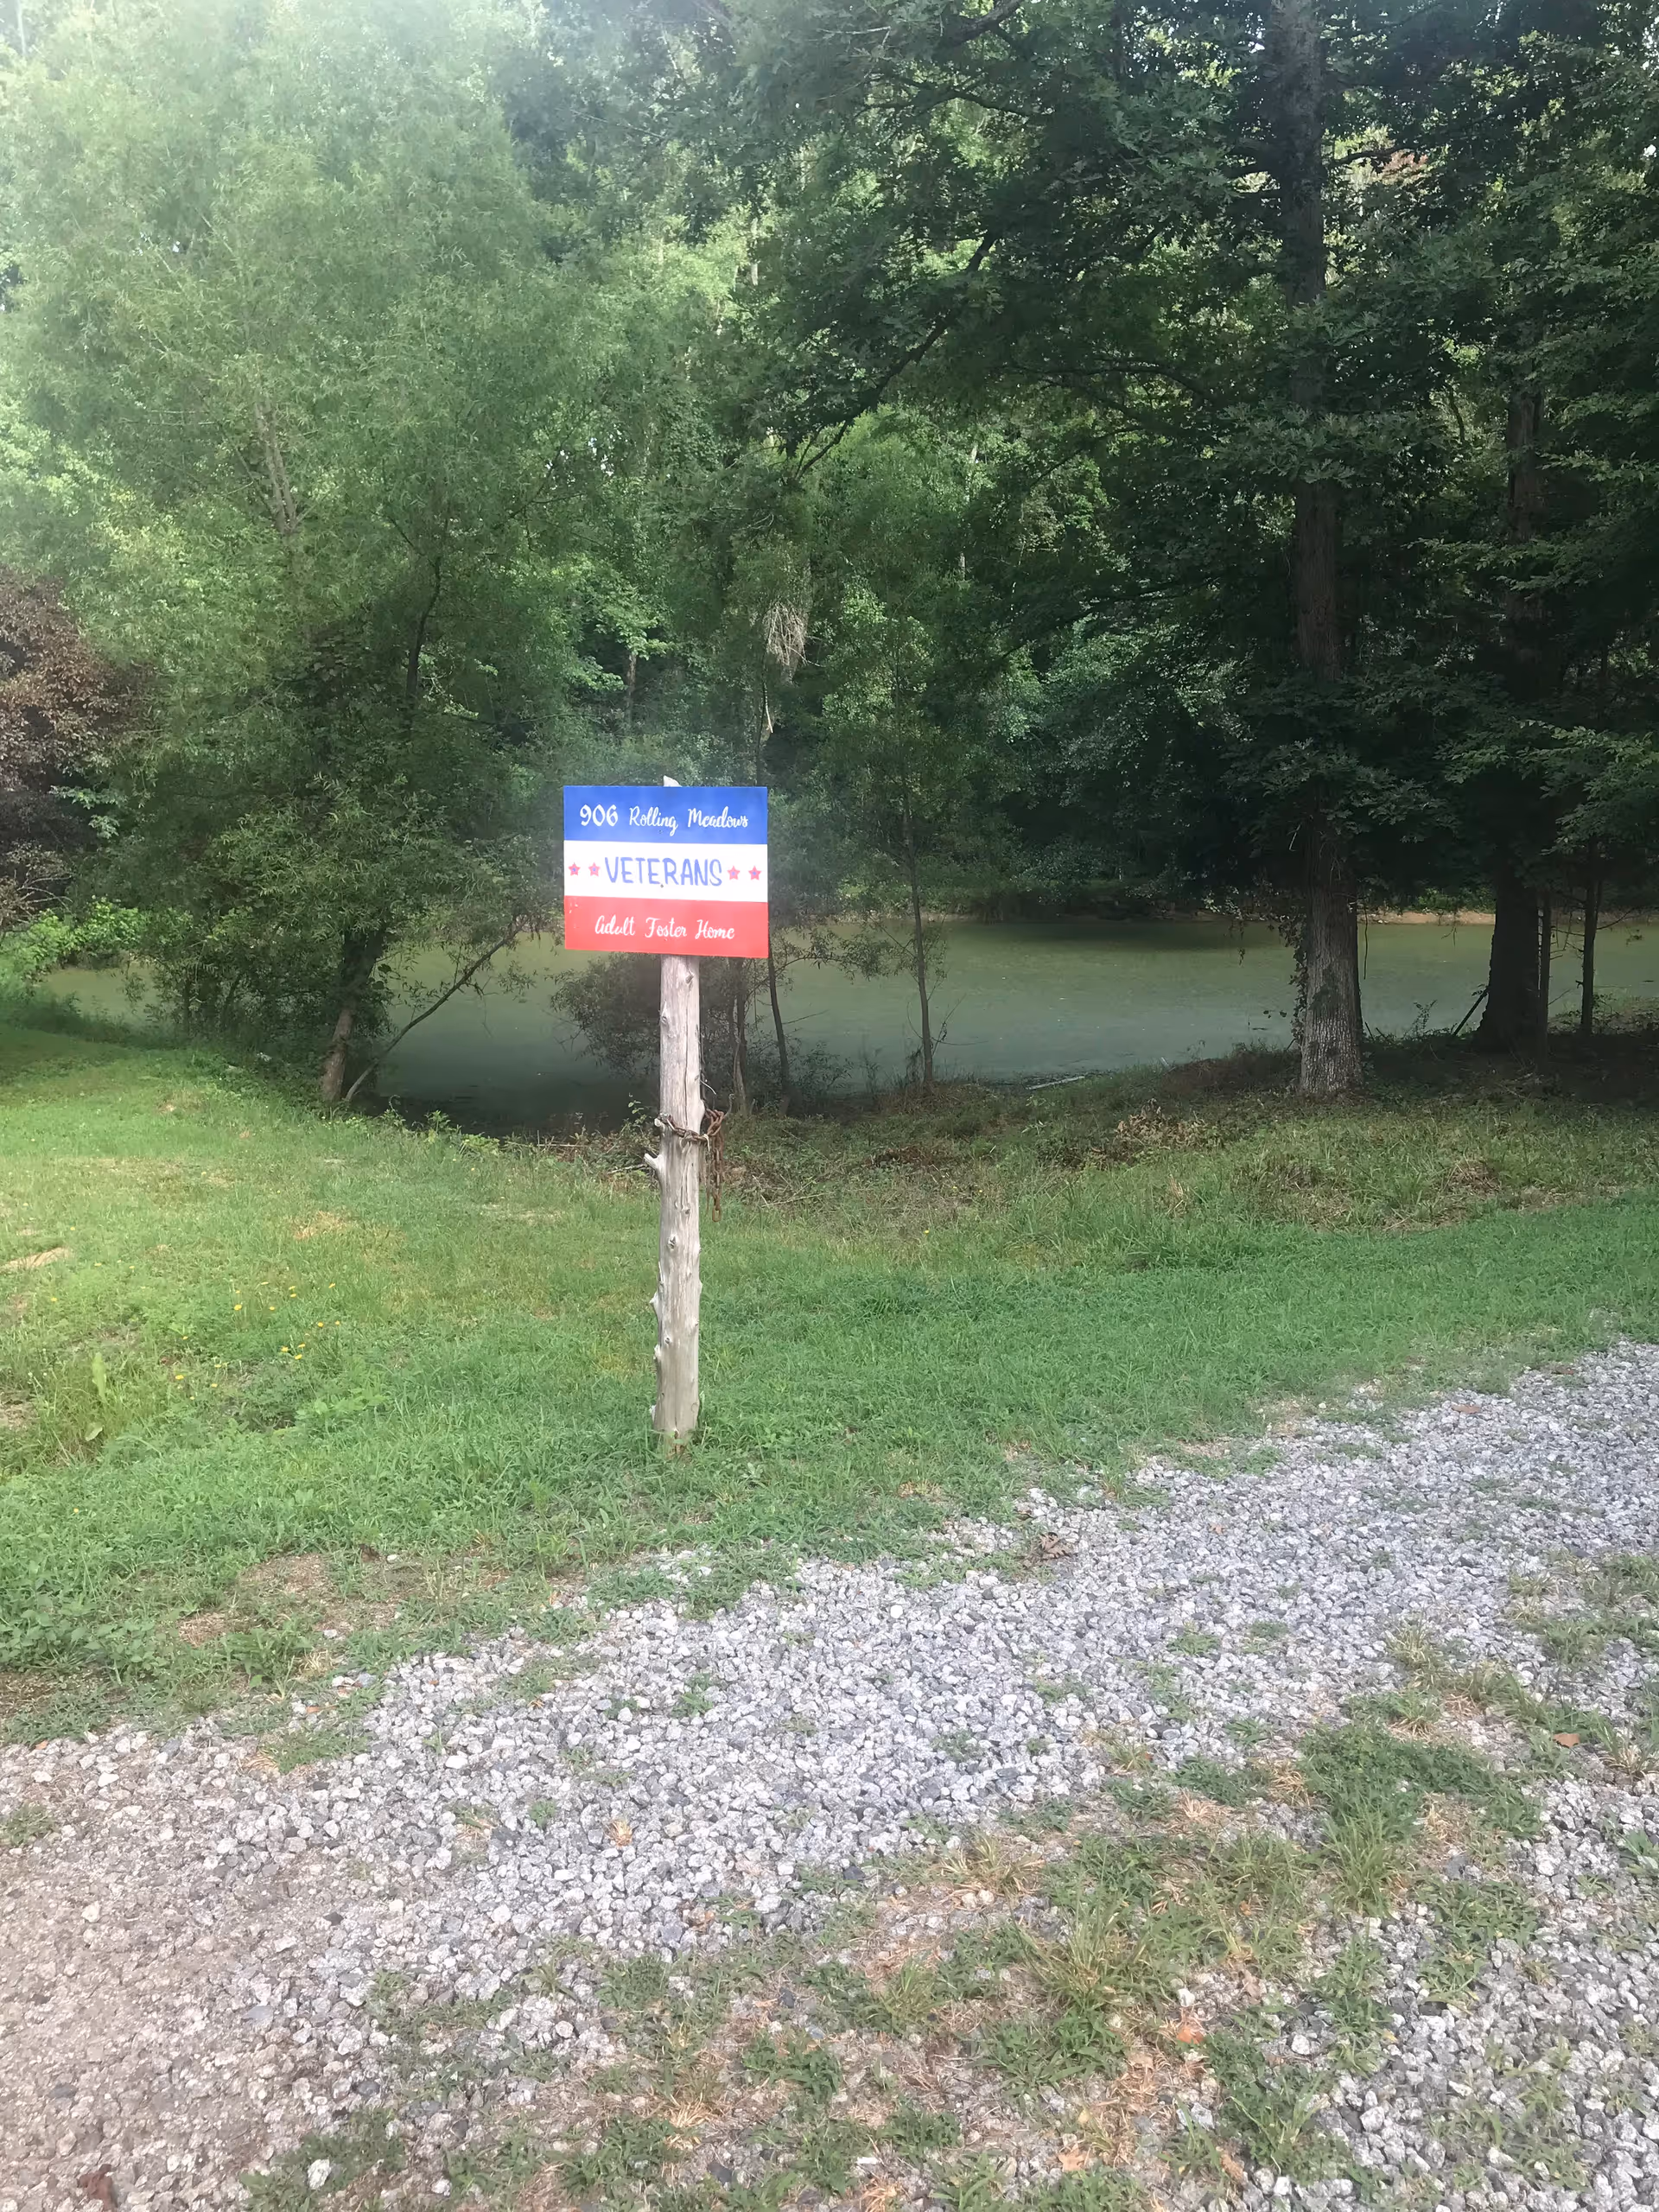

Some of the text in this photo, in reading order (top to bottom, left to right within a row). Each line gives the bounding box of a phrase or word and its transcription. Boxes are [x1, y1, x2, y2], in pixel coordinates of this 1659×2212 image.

[579, 804, 749, 837] 906 Rolling Meadows
[604, 856, 722, 887] VETERANS
[594, 914, 735, 940] Adult Foster Home
